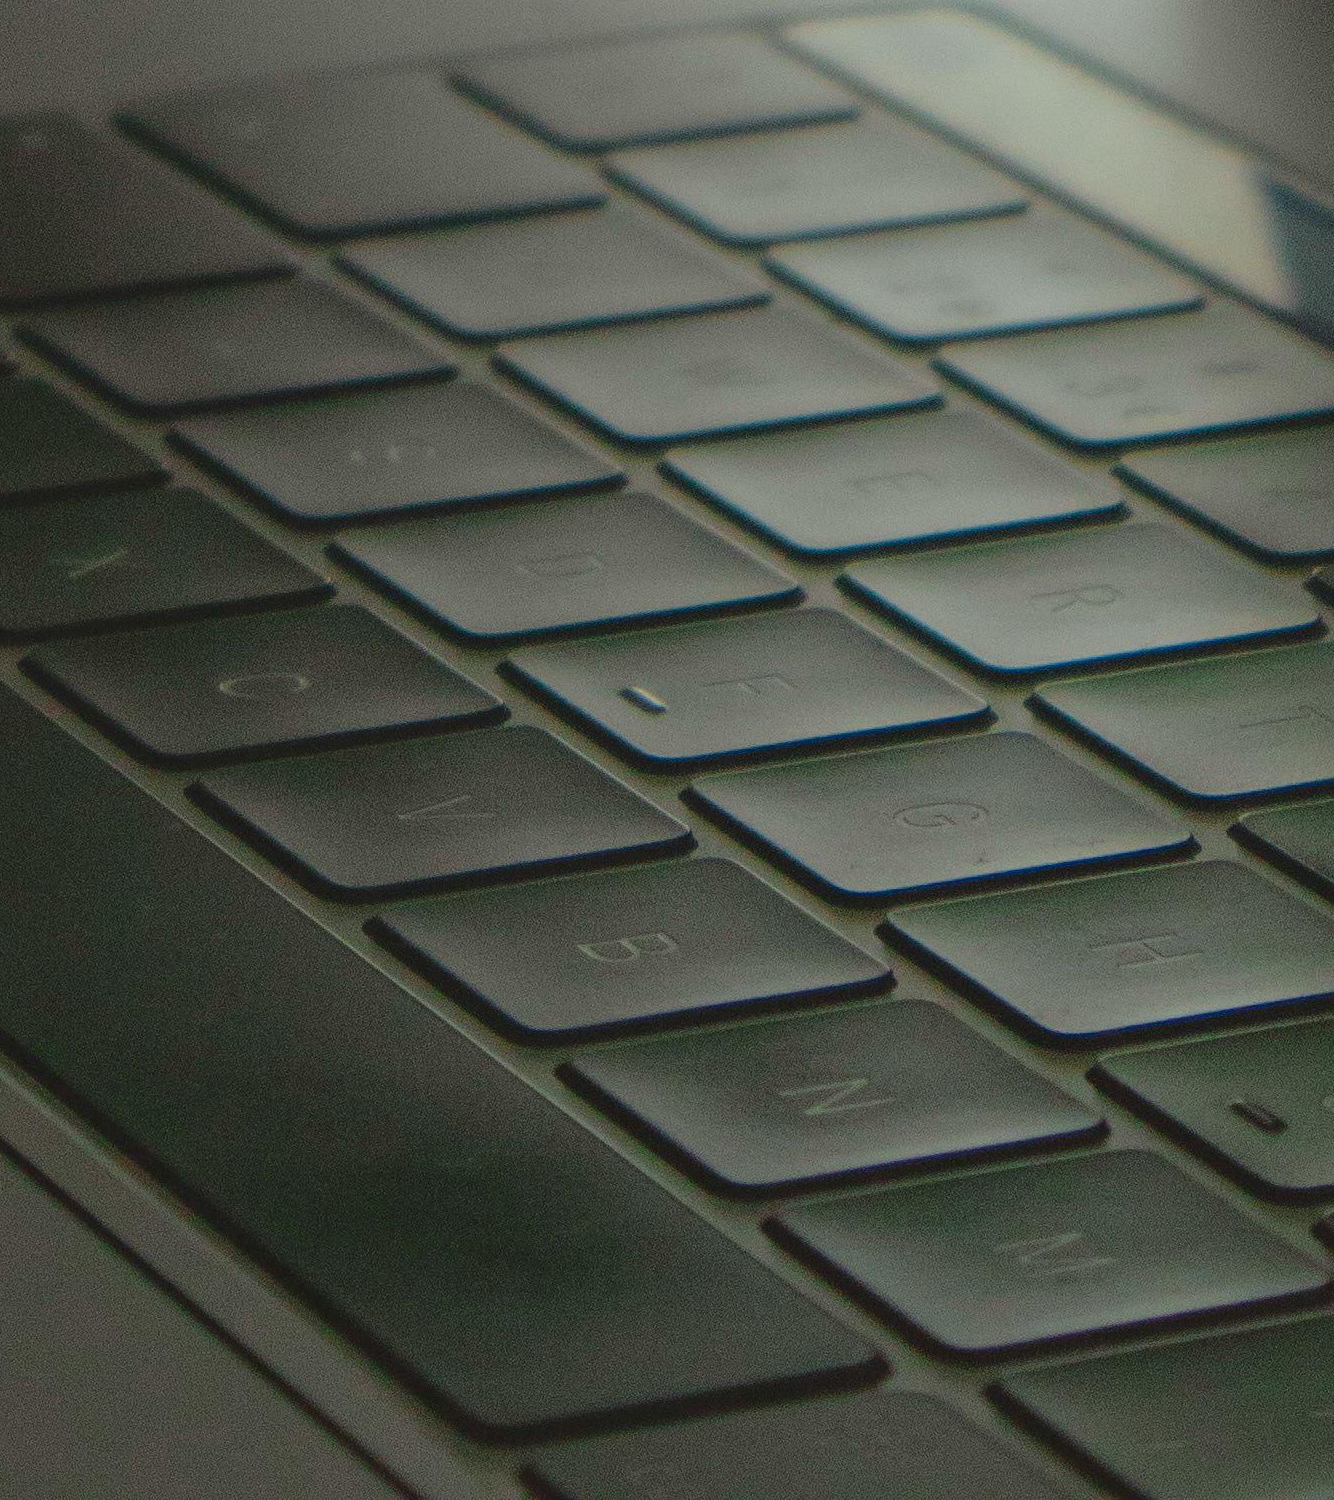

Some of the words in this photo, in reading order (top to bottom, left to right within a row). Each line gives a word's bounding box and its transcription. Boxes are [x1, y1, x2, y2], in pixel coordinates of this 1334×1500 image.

[1030, 580, 1125, 614] R
[215, 670, 312, 702] C
[703, 672, 799, 697] F
[396, 794, 495, 822] V
[890, 799, 993, 831] G
[575, 929, 680, 965] B
[1087, 927, 1205, 969] H
[775, 1075, 899, 1119] N
[993, 1229, 1119, 1285] M
